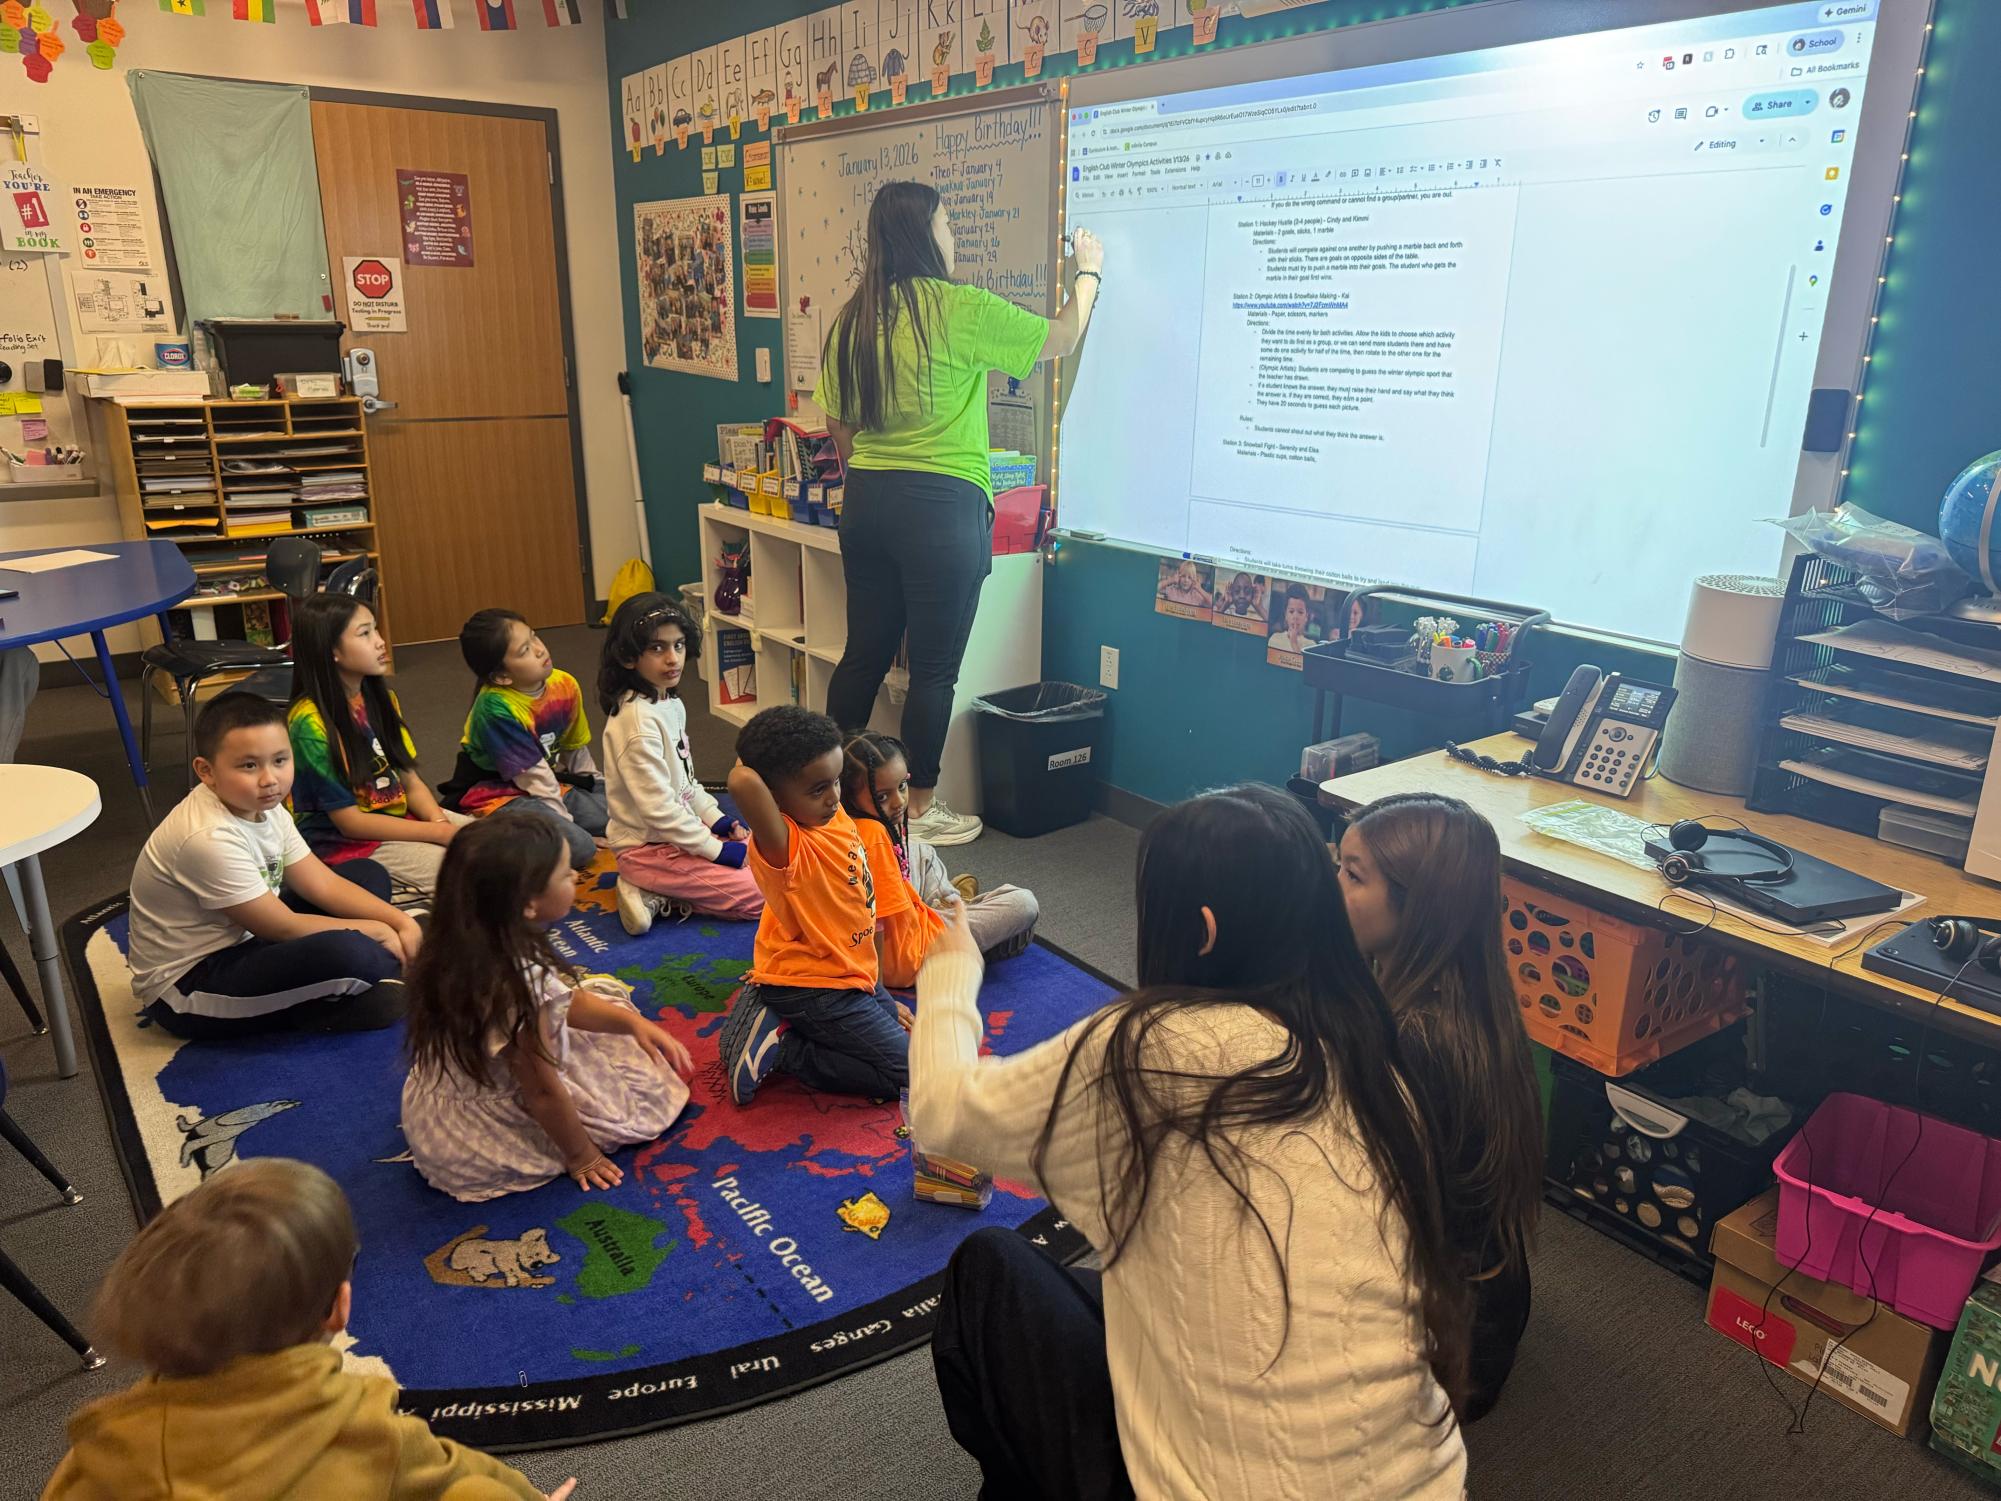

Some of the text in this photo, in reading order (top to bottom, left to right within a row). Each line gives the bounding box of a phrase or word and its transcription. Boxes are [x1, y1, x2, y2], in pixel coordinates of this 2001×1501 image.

[1836, 5, 1866, 17] Gemini
[1140, 25, 1150, 45] V
[1808, 37, 1837, 48] School
[1806, 61, 1860, 74] All Bookmarks
[1767, 99, 1793, 110] Share
[935, 123, 968, 160] Happy
[1709, 139, 1736, 151] Editing
[838, 152, 878, 180] January
[893, 142, 919, 167] 2026
[995, 158, 1002, 173] 4
[4, 181, 50, 191] YOU'RE
[83, 187, 92, 195] AN
[94, 188, 136, 196] EMERGENCY
[21, 198, 45, 222] #1
[16, 237, 61, 248] BOOK
[987, 250, 997, 262] 29
[357, 274, 389, 285] STOP
[1049, 753, 1087, 769] Room 126
[564, 920, 609, 953] Atlantic
[585, 1220, 635, 1277] Australia
[711, 1176, 834, 1303] Pacific Ocean
[810, 1320, 892, 1352] Ganges
[731, 1355, 781, 1379] Ural
[1968, 1351, 2001, 1393] N
[607, 1375, 698, 1400] Europe
[430, 1395, 582, 1422] Mississippi
